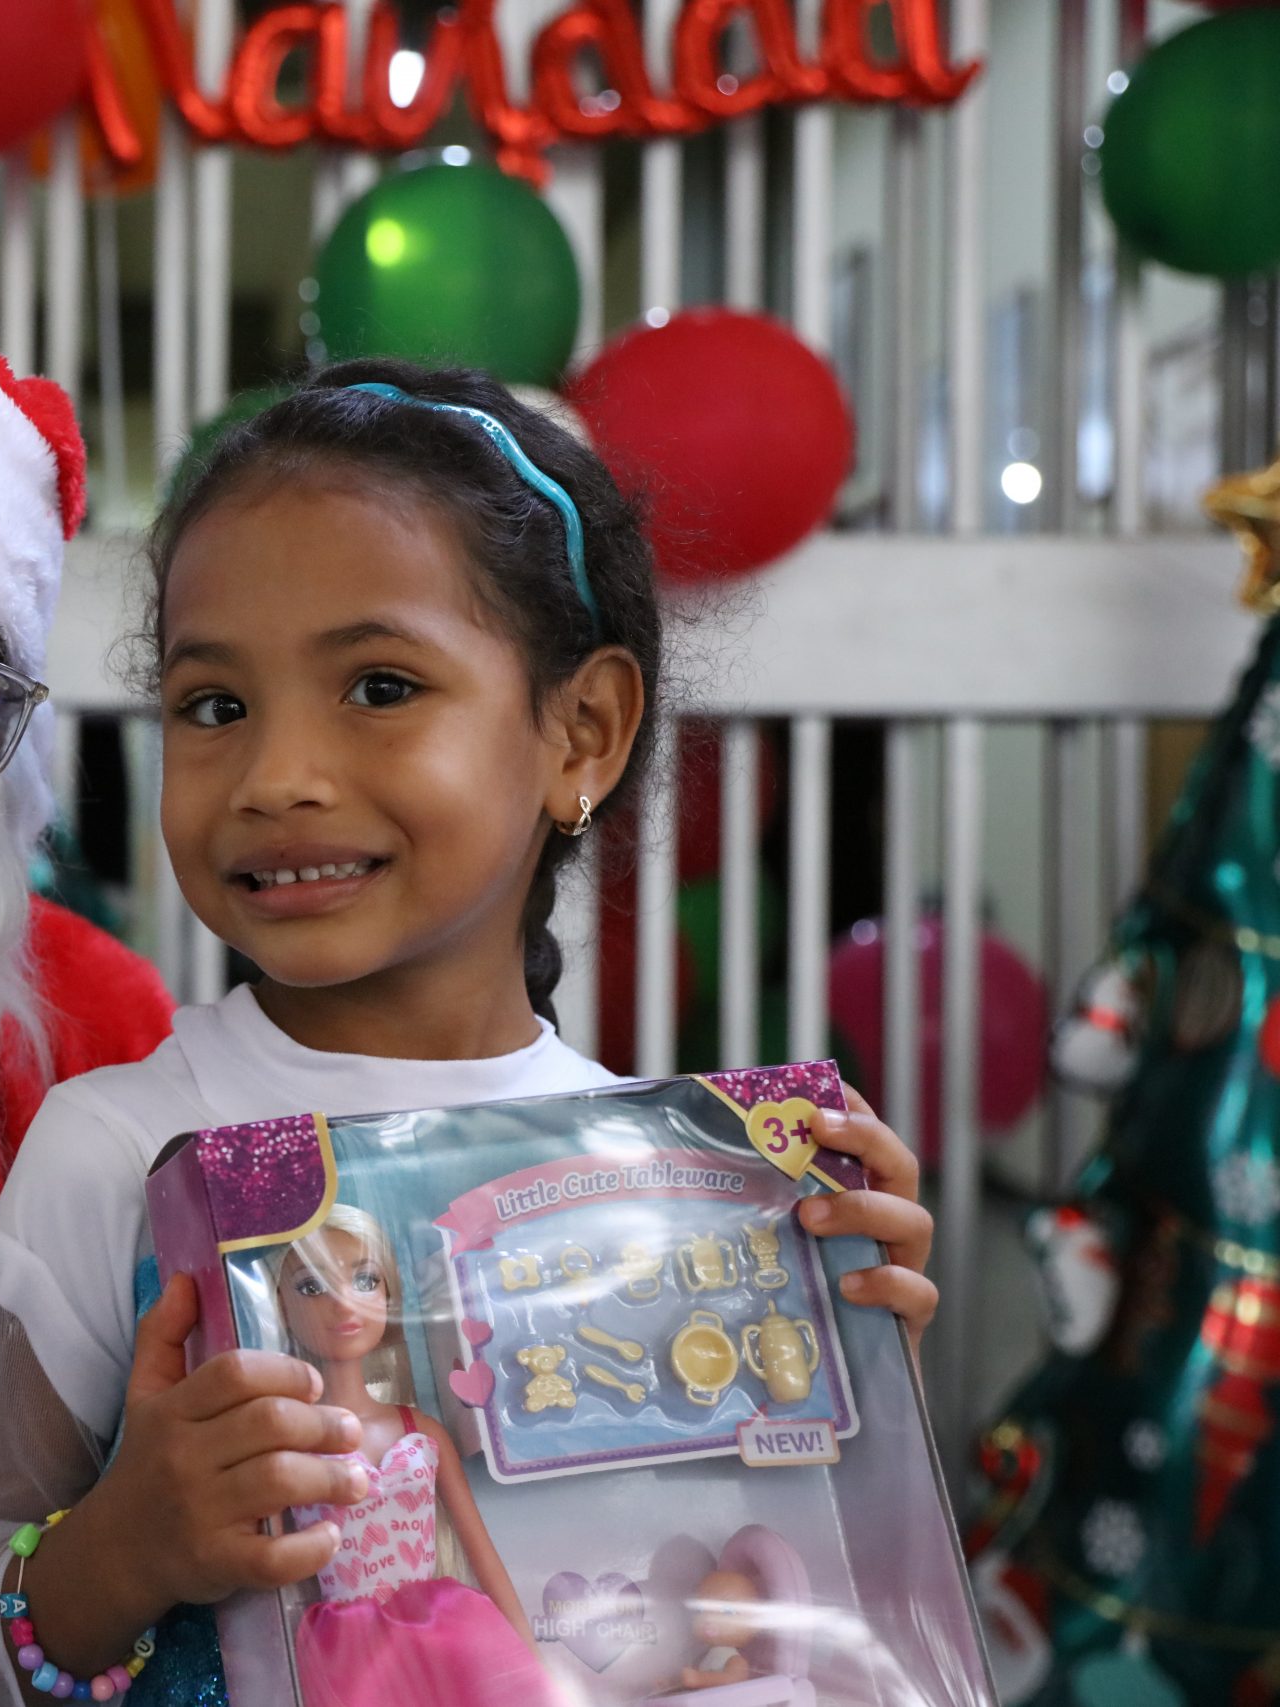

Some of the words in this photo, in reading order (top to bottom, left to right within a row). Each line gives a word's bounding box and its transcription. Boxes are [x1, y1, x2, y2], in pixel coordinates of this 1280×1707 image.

[763, 1117, 812, 1154] 3+
[496, 1180, 560, 1219] Little
[563, 1172, 618, 1196] Cute
[622, 1161, 744, 1191] Tableware
[754, 1430, 824, 1454] NEW!
[390, 1519, 424, 1534] love
[363, 1553, 396, 1578] love
[534, 1617, 587, 1639] HIGH
[595, 1621, 654, 1642] CHAIR
